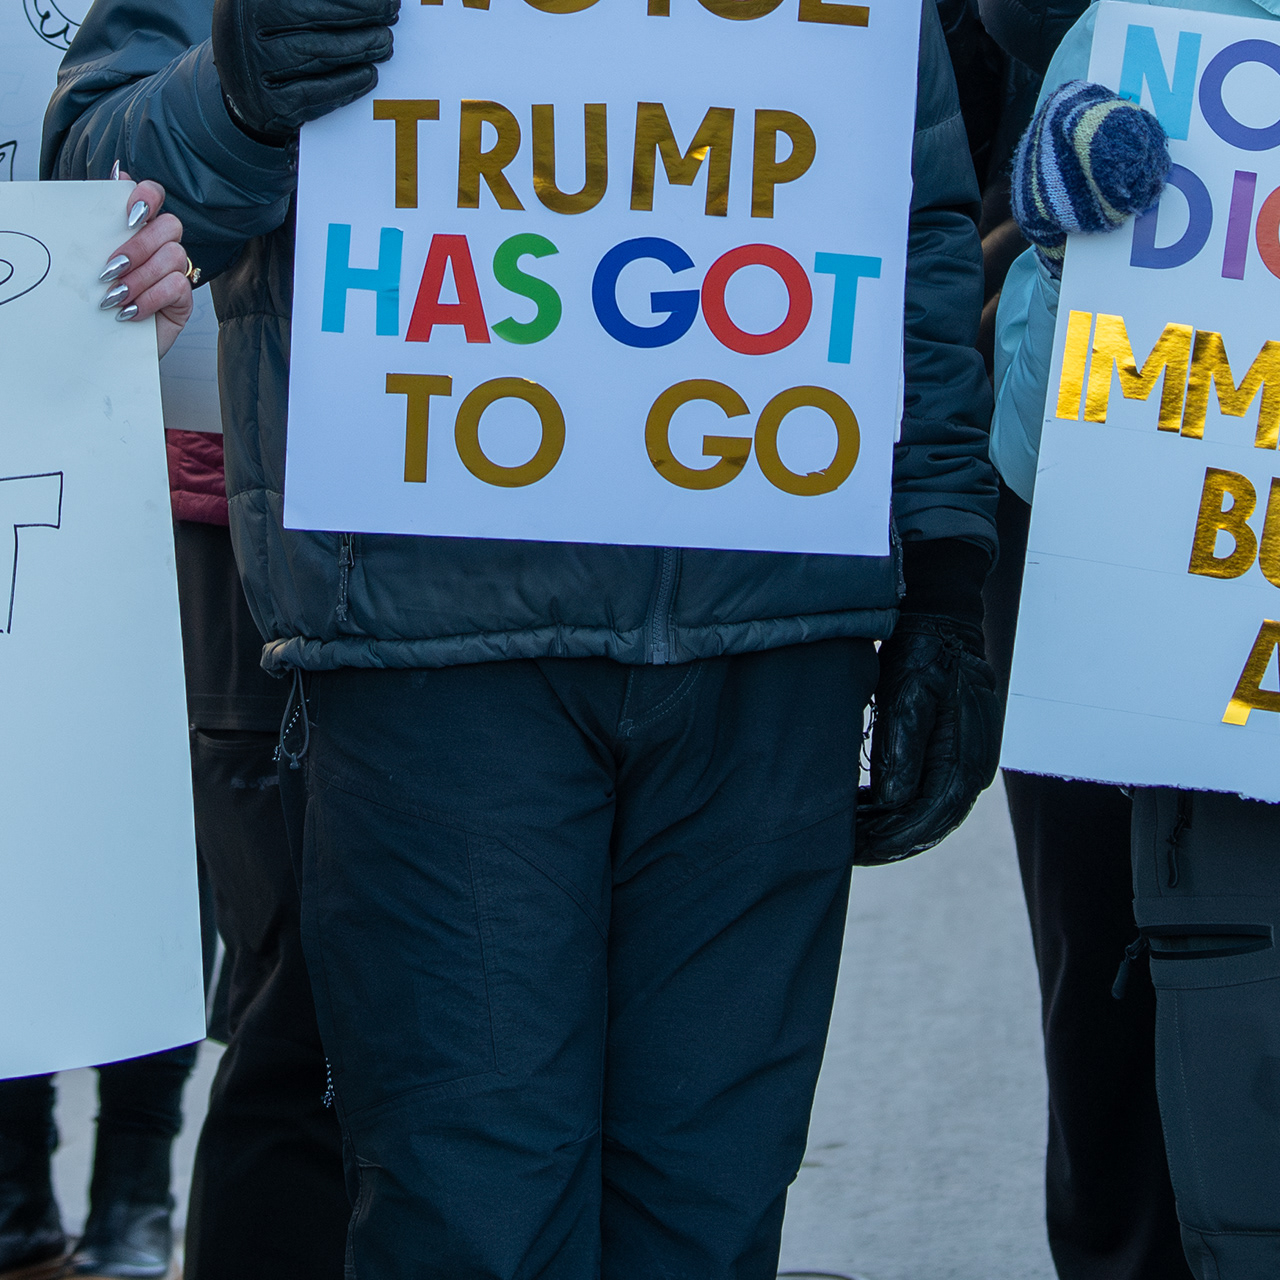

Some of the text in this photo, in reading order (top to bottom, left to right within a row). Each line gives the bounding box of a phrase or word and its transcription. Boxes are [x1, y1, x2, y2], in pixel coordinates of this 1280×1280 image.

[373, 99, 817, 218] TRUMP
[320, 222, 883, 365] HAS GOT
[384, 372, 861, 497] TO GO
